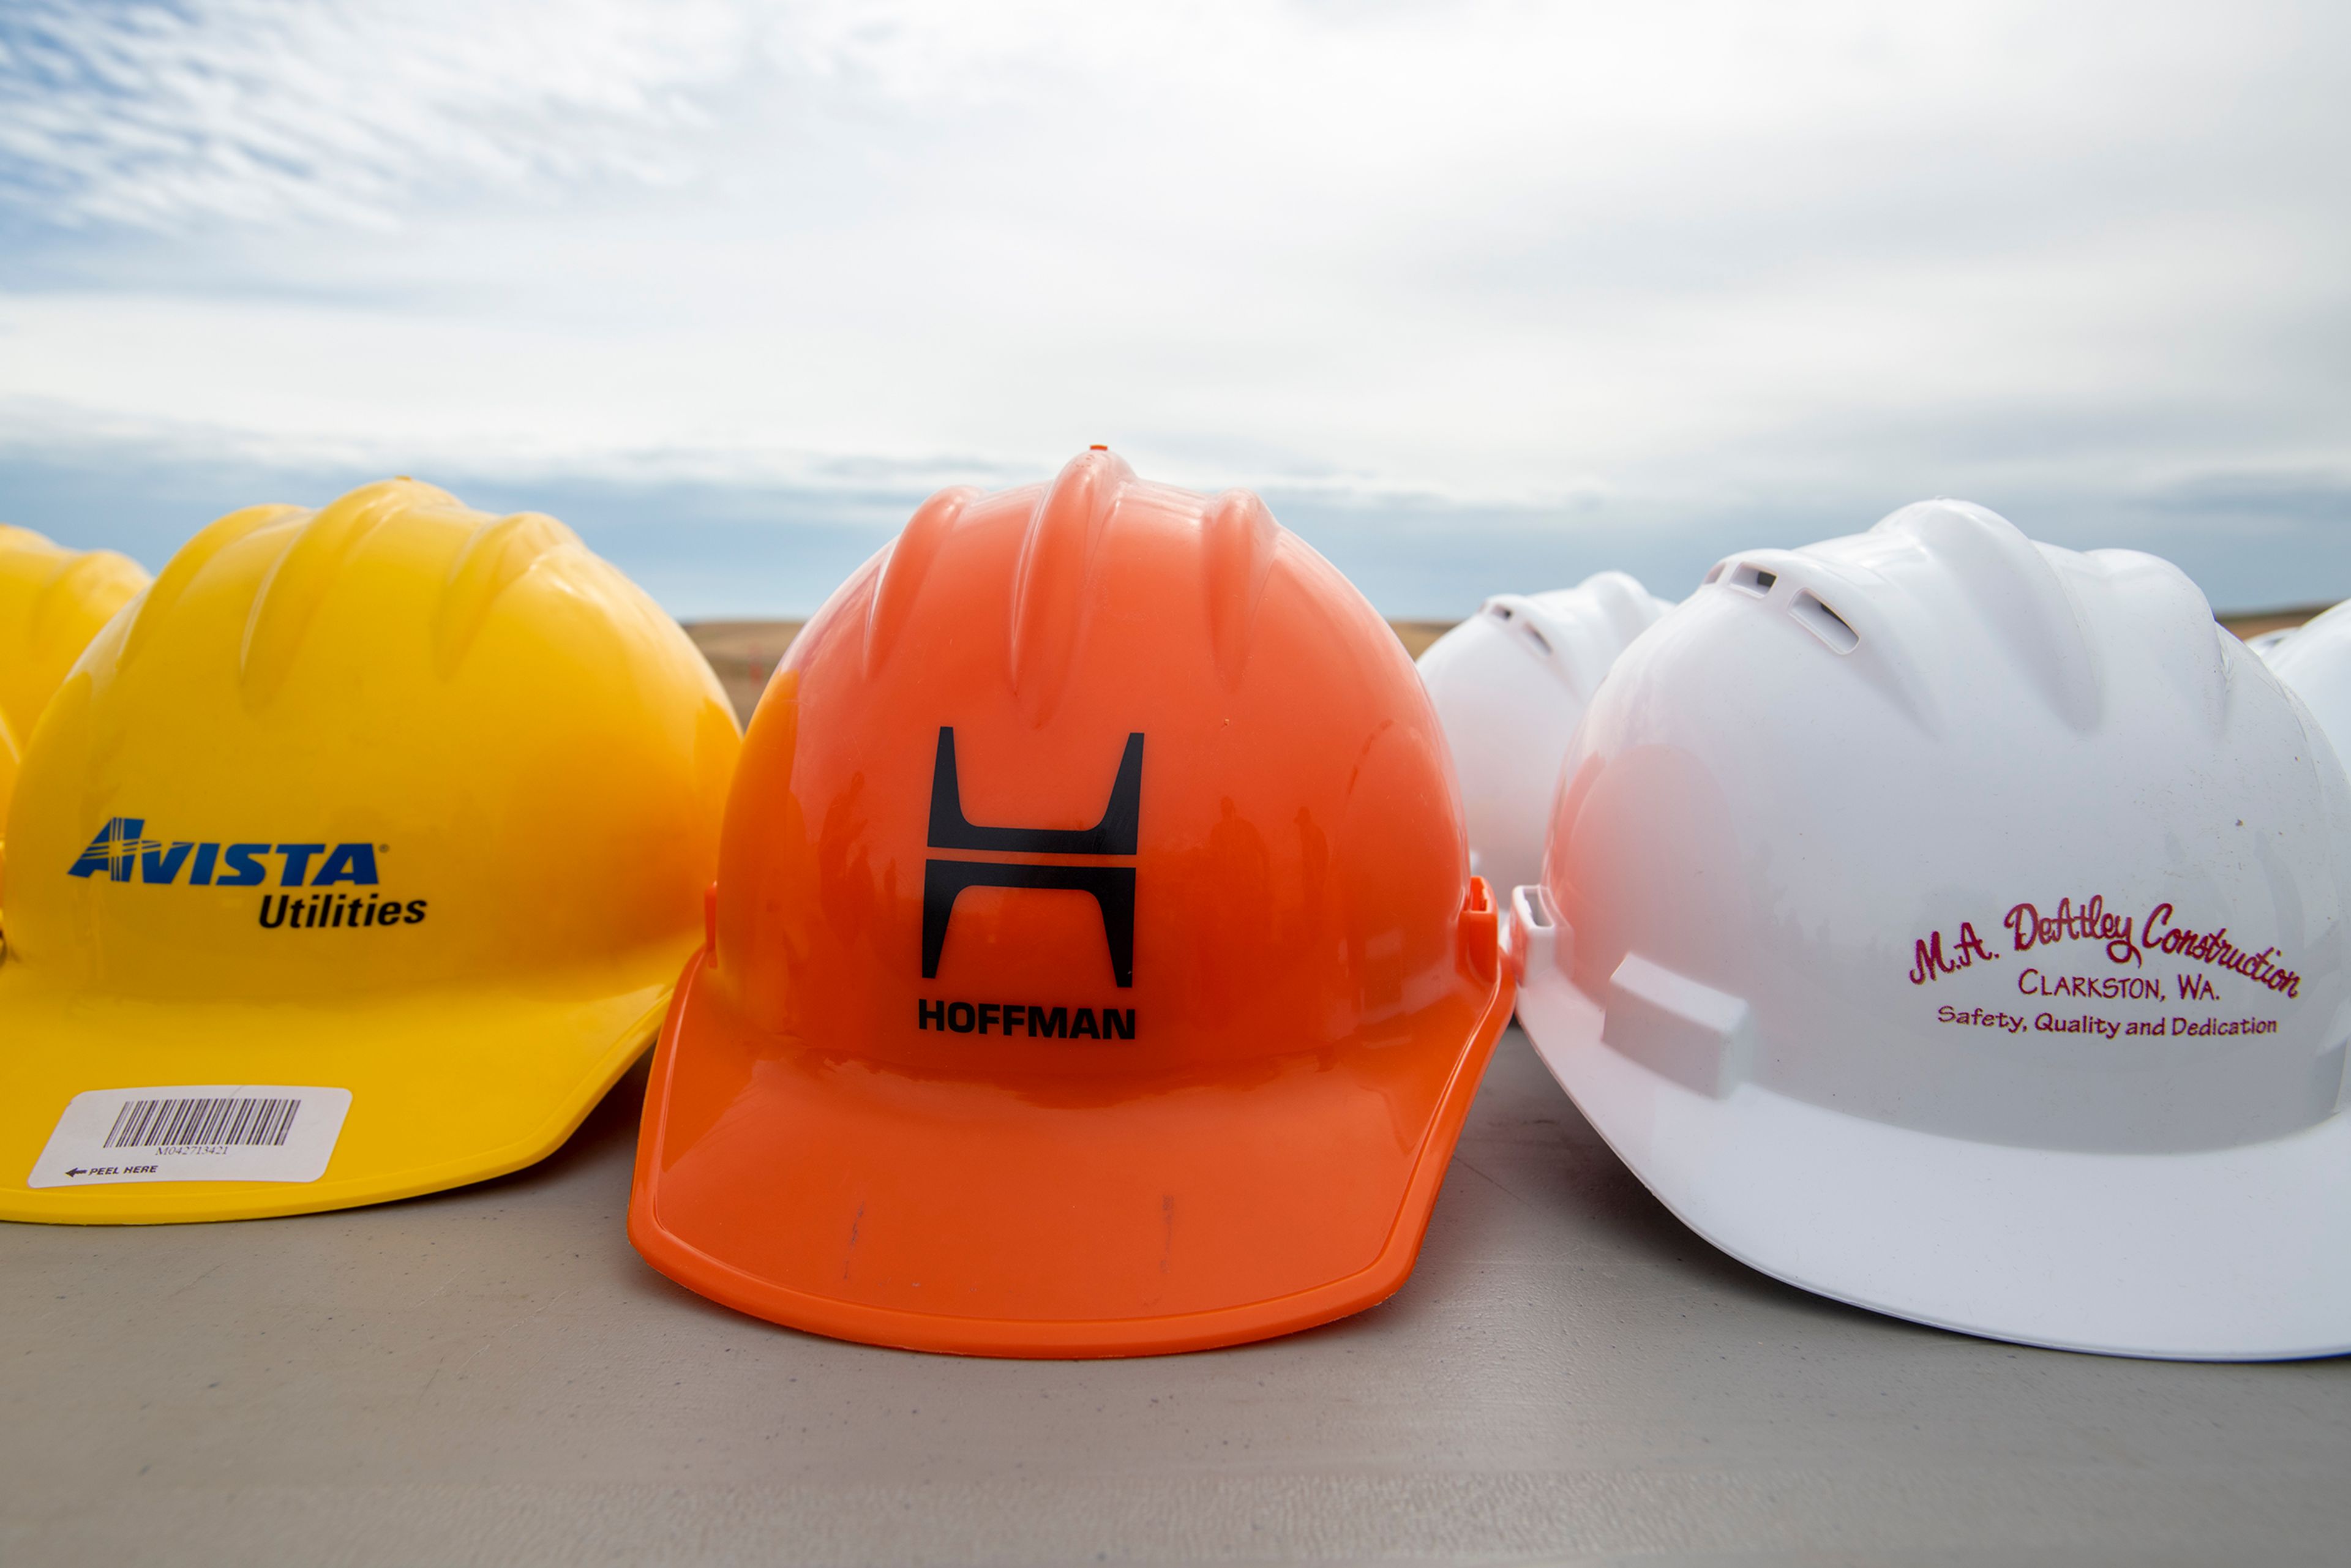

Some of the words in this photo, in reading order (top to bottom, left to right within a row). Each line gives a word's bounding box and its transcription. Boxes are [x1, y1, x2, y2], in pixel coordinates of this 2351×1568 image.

[258, 893, 427, 929] Utilities
[1909, 921, 2000, 985] M.A.
[2003, 894, 2142, 969] DeAtley
[2143, 902, 2300, 1000] Construction
[918, 999, 1136, 1040] HOFFMAN
[1937, 1005, 2027, 1033] Safety,
[2034, 1012, 2121, 1039] Quality
[2125, 1017, 2165, 1036] and
[2172, 1016, 2278, 1035] Dedication
[155, 1146, 228, 1156] M042713421
[89, 1166, 119, 1176] PEEL
[123, 1165, 159, 1174] HERE
